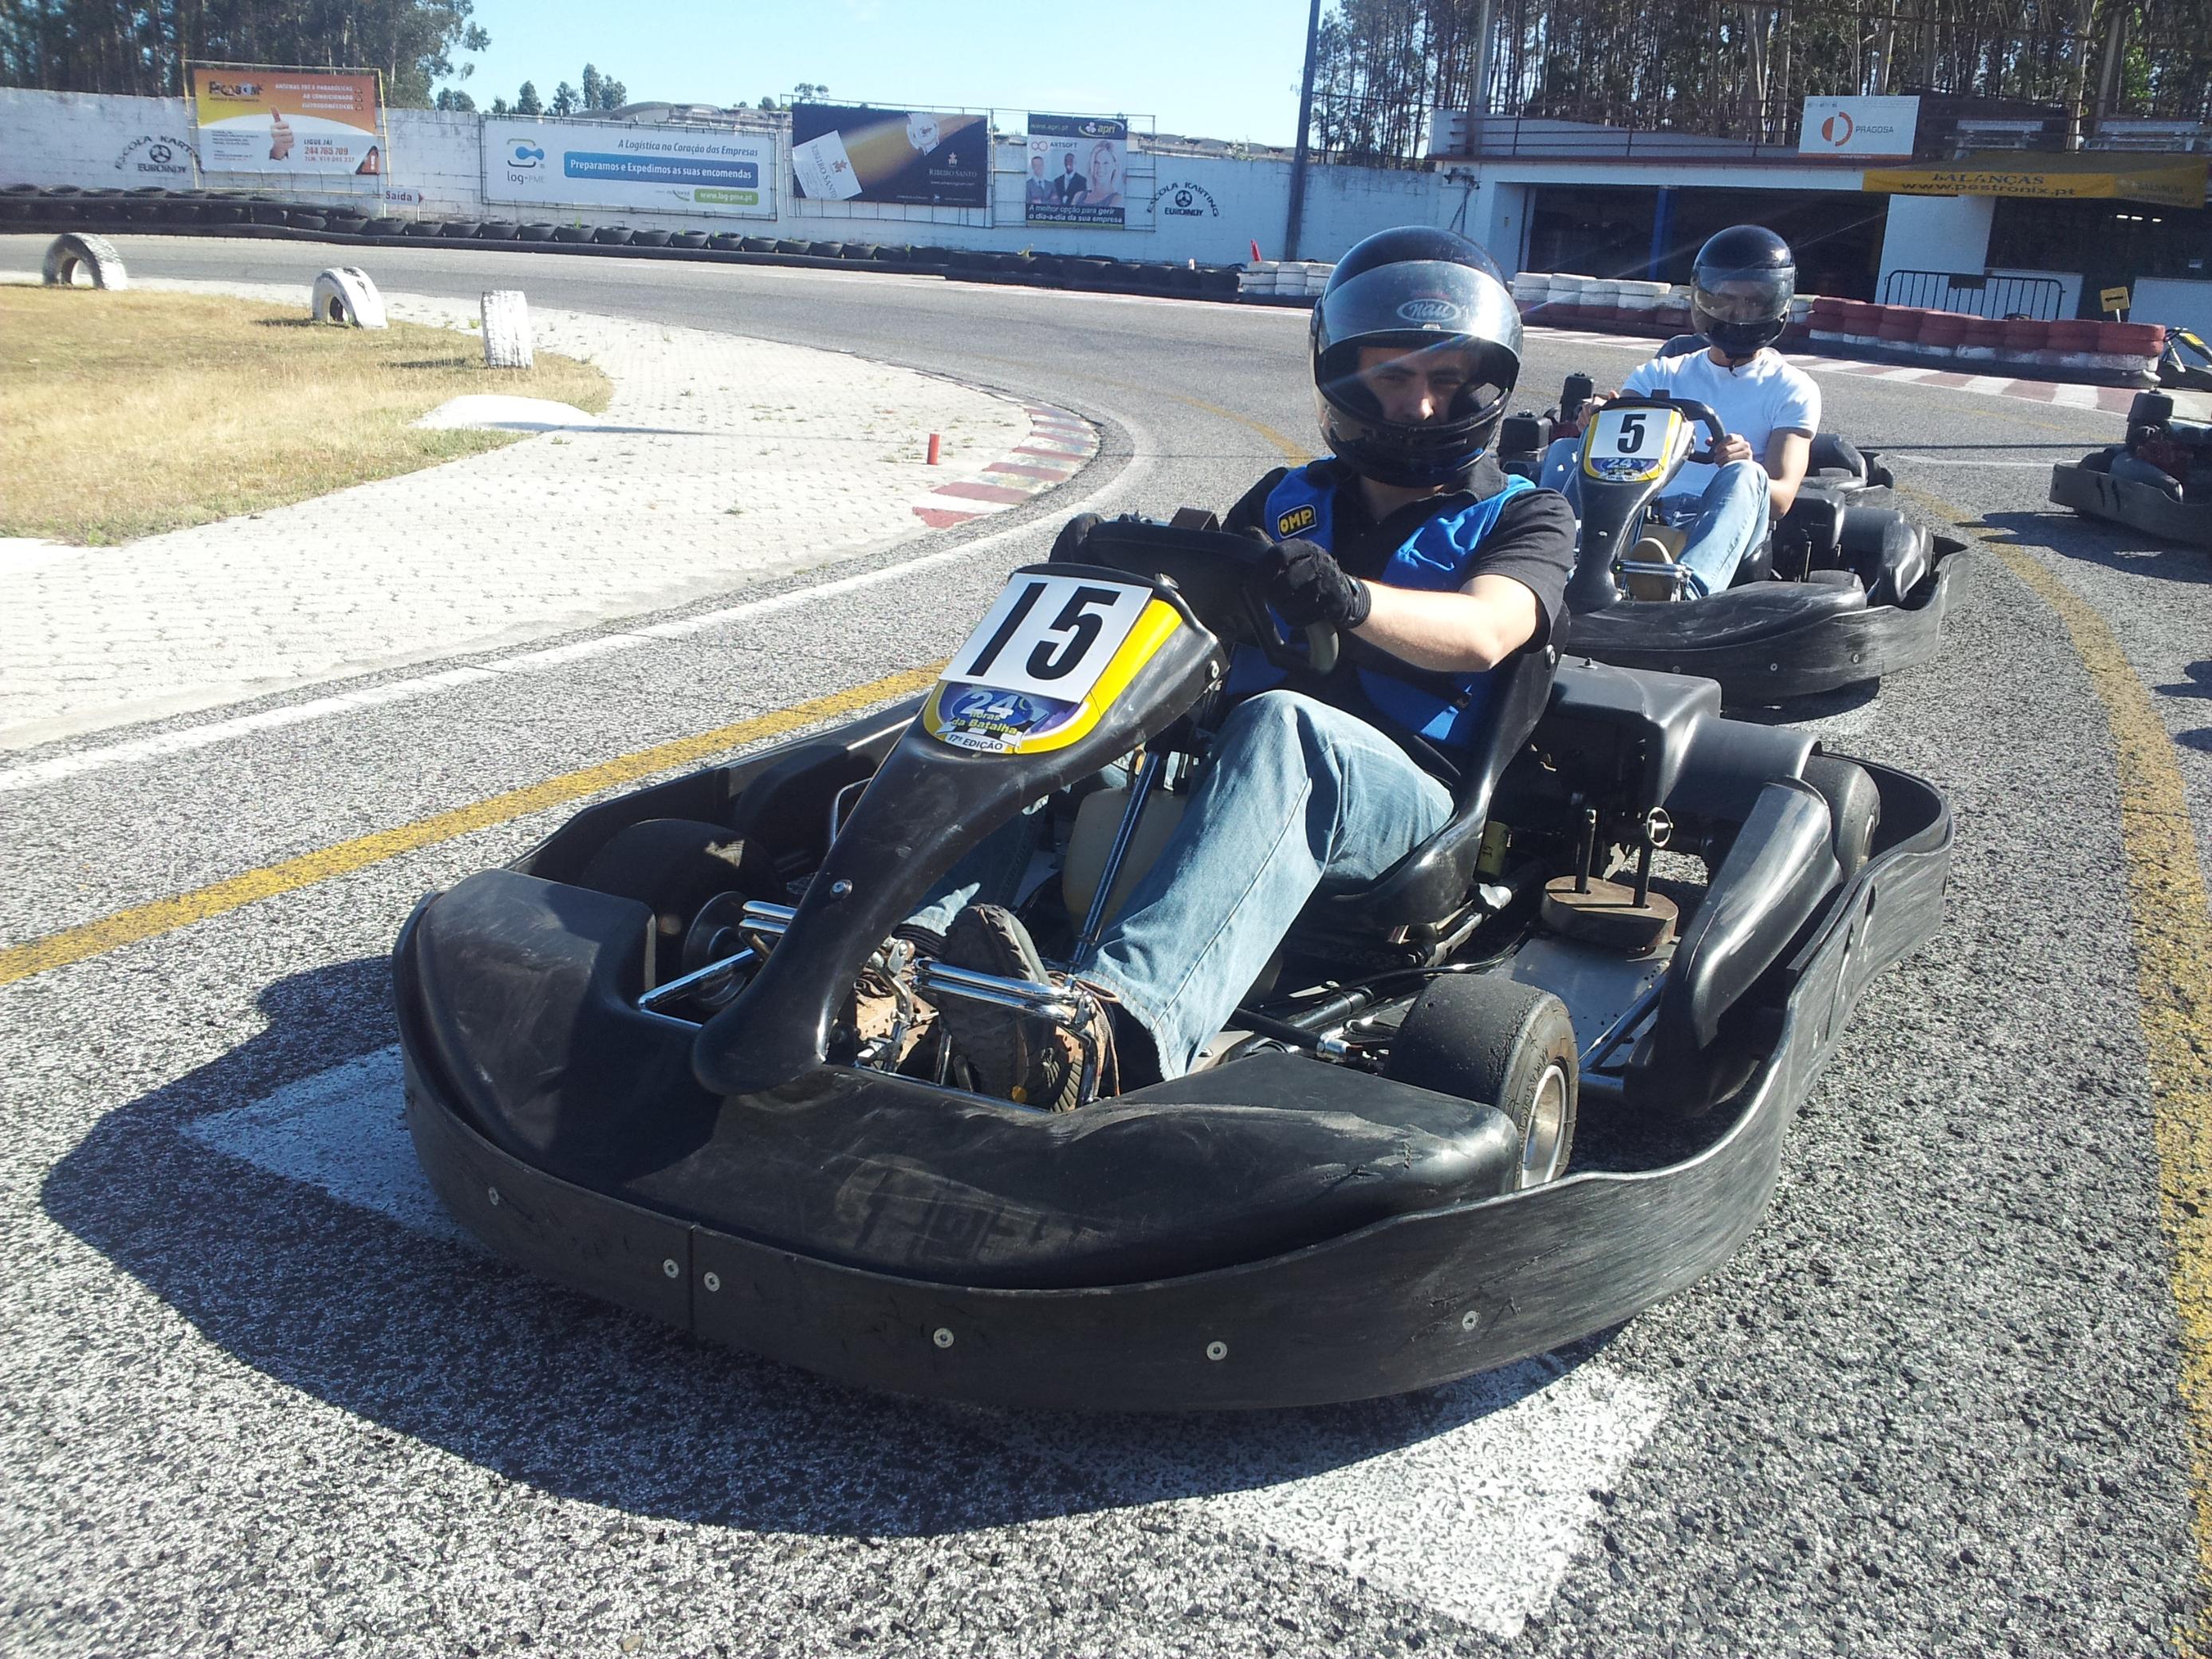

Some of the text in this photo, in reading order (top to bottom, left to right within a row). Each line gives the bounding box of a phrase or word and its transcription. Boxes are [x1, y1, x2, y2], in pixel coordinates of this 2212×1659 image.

[1097, 124, 1116, 135] apri
[618, 140, 624, 148] A
[625, 140, 660, 152] Logística
[674, 143, 704, 155] Coração
[707, 145, 719, 154] das
[722, 145, 758, 157] Empresas
[570, 160, 620, 171] Preparamos
[628, 163, 671, 174] Expedimos
[702, 169, 752, 179] encomendas
[1902, 183, 2076, 196] www.pestronix.pt
[1184, 182, 1219, 217] KARTING
[1164, 207, 1204, 216] EUROINDY
[1617, 413, 1647, 454] 5
[1607, 458, 1633, 468] 24
[1280, 509, 1312, 533] OMP
[966, 581, 1122, 680] 15
[960, 691, 1019, 719] 24
[969, 711, 1002, 721] horas
[968, 719, 1019, 735] Batalha
[962, 737, 1003, 751] EDIÇÃO
